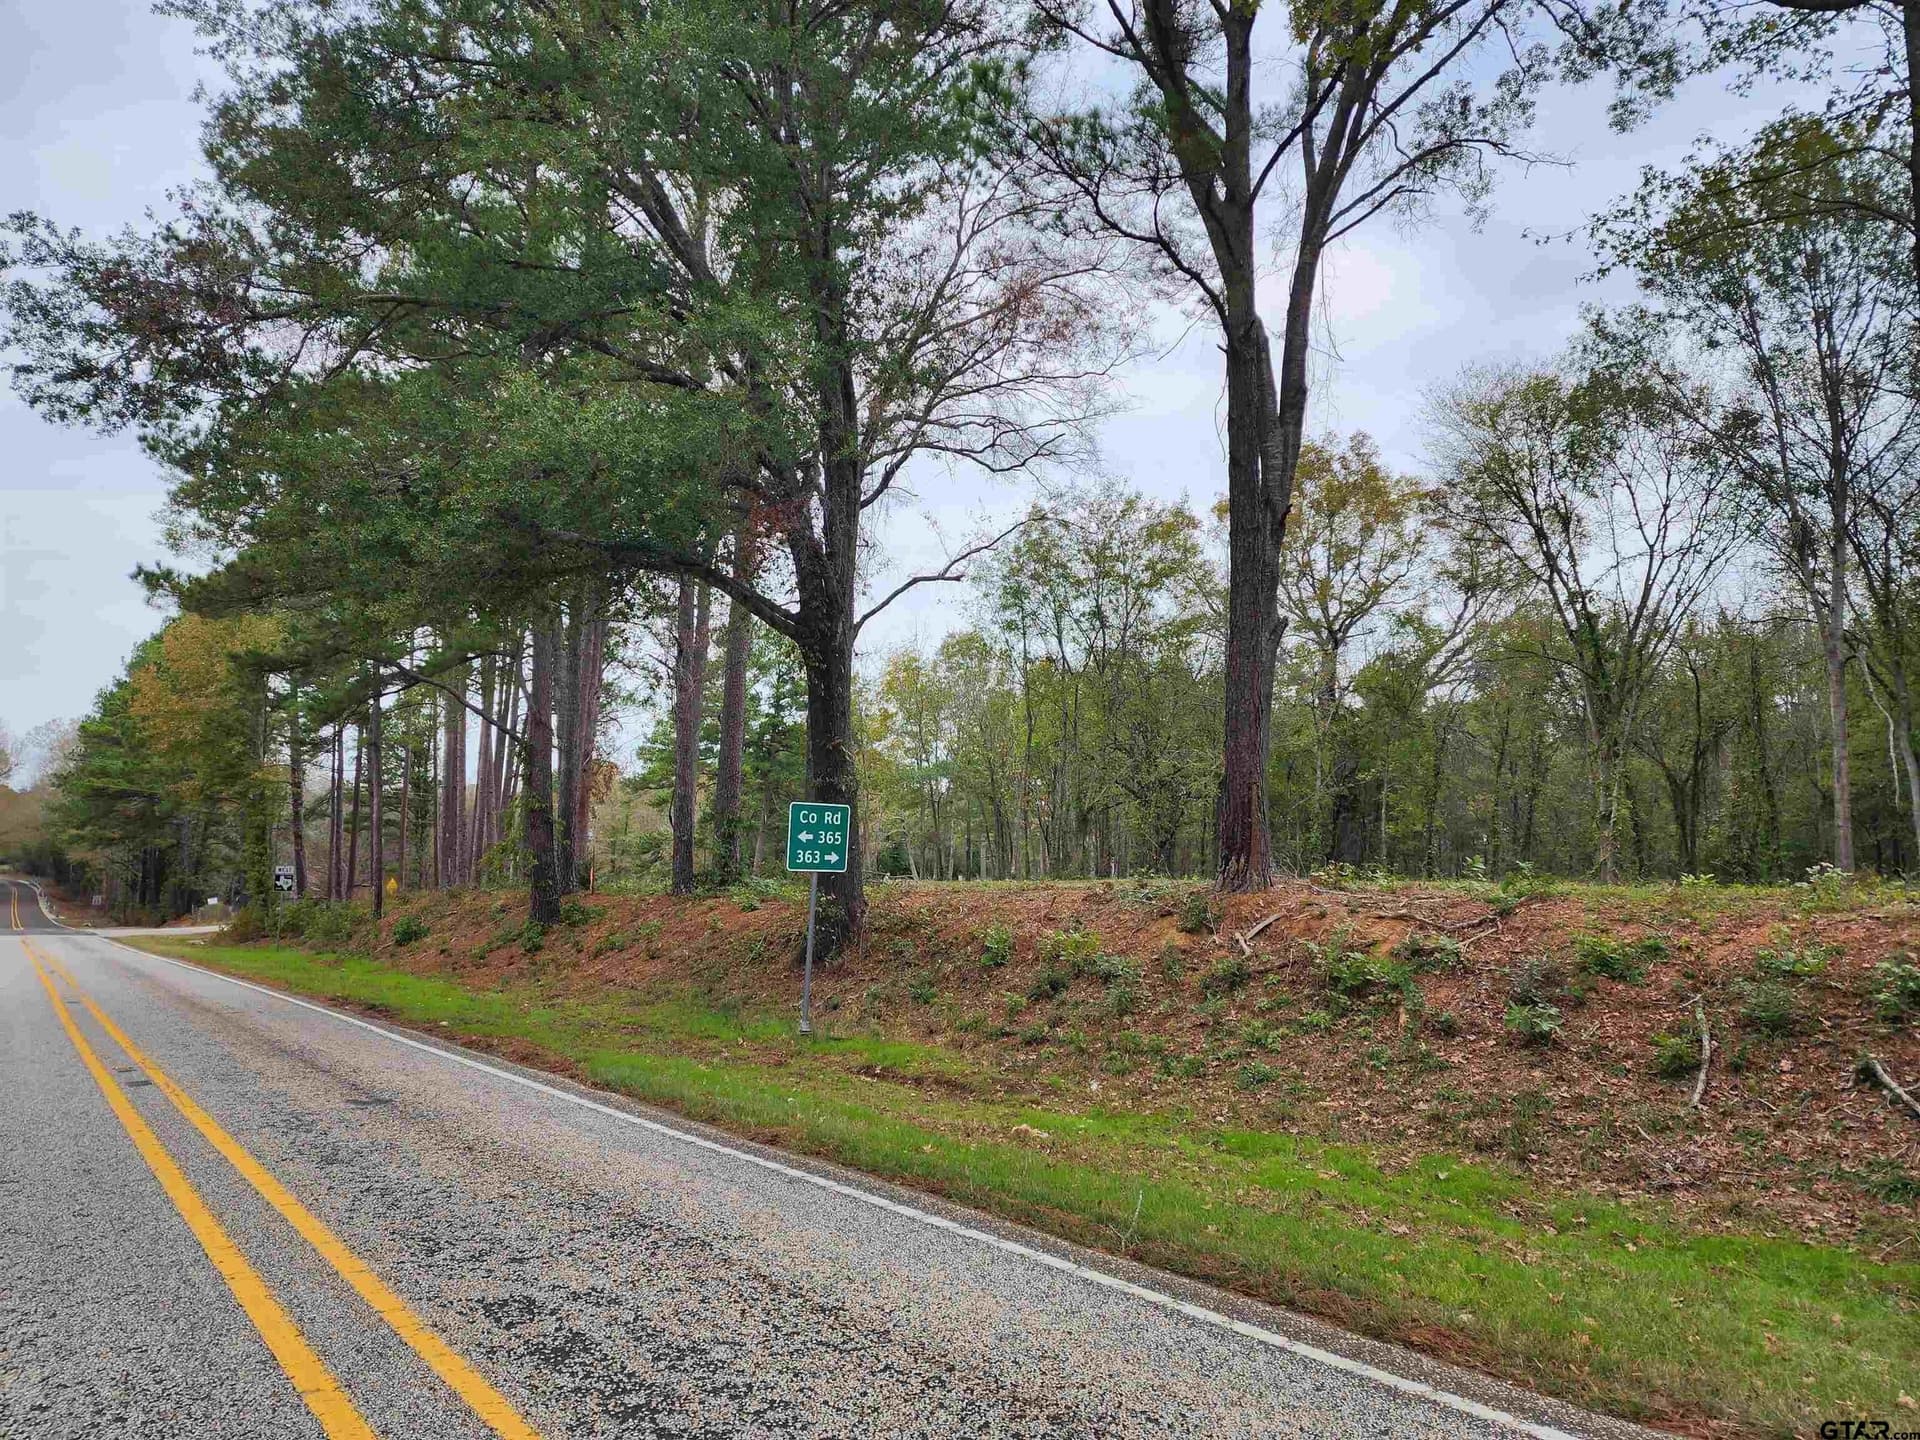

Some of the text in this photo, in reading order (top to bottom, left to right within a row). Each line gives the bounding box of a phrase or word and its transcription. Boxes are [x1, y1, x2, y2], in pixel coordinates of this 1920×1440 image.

[800, 811, 841, 824] Co Rd
[818, 831, 841, 844] 365
[796, 850, 820, 863] 363
